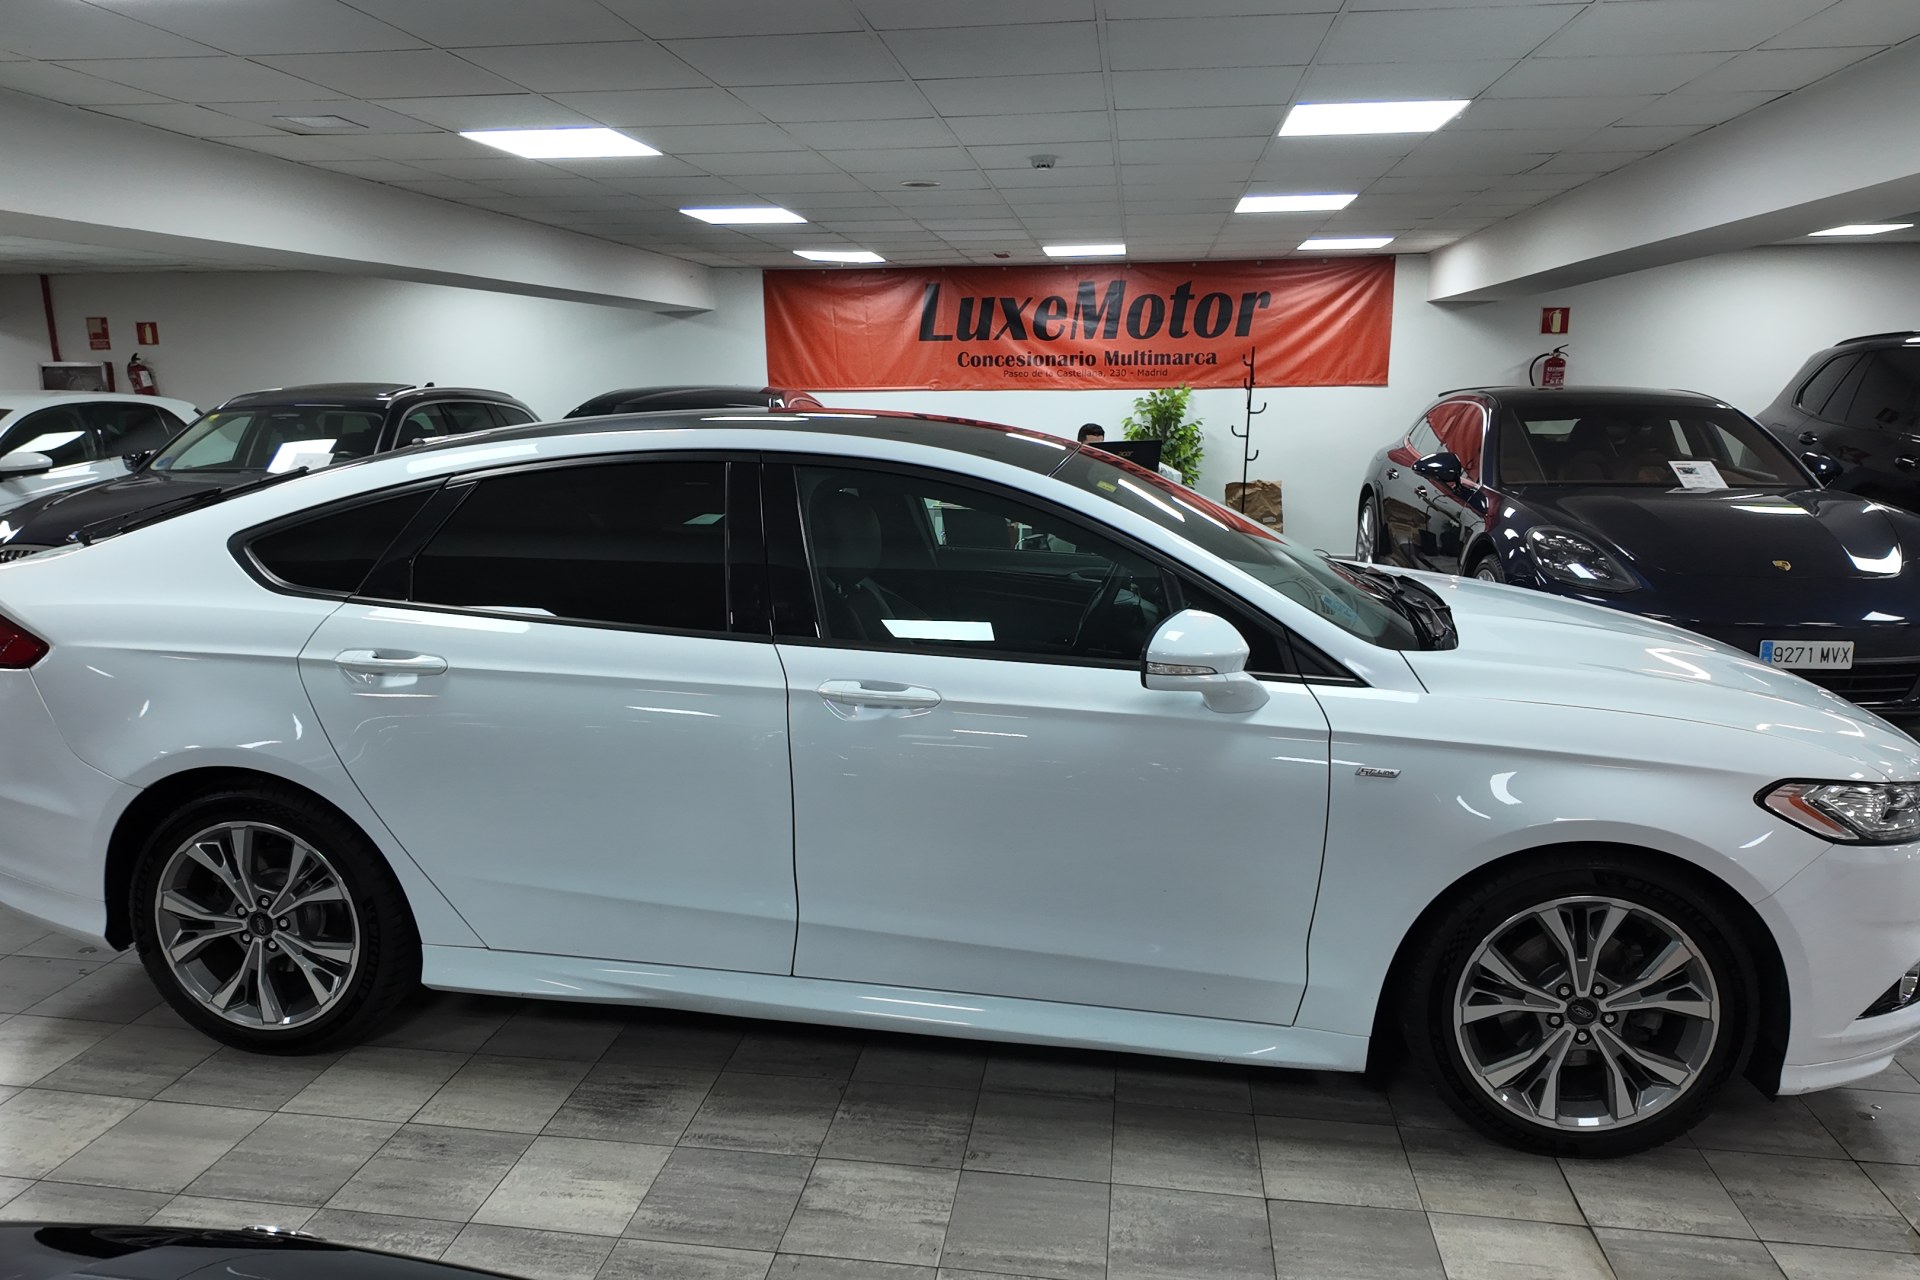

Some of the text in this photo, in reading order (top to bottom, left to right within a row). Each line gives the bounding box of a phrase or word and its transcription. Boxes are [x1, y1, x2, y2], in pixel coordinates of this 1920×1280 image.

[918, 280, 1272, 342] LuxeMotor
[957, 350, 1218, 368] Concesionario Multimarca
[1003, 369, 1029, 378] Paseo
[1031, 369, 1043, 378] de
[1109, 369, 1127, 377] 230
[1137, 368, 1168, 377] Madrid
[1773, 646, 1851, 664] 9271 MVX
